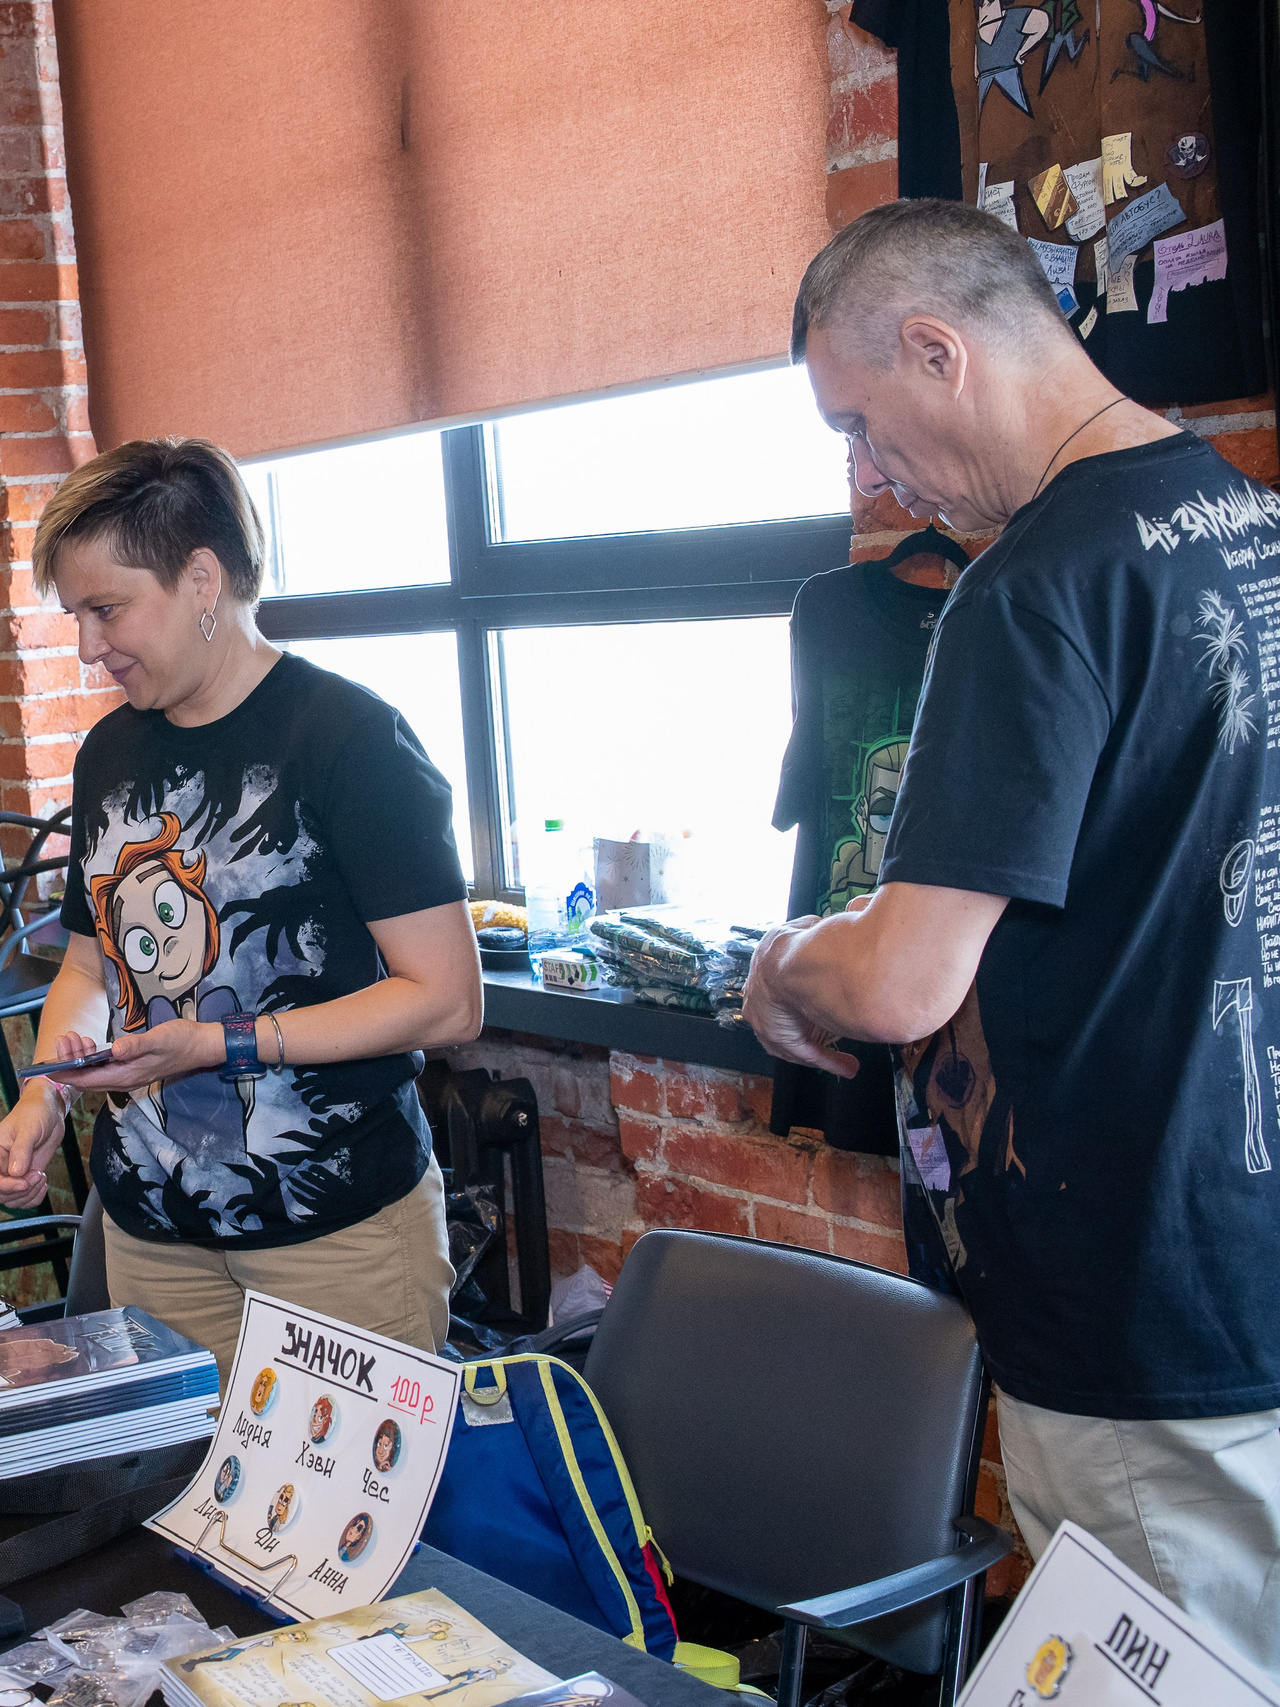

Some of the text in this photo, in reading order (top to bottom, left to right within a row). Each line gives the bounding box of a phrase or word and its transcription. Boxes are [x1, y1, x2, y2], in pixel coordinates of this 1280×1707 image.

[281, 1321, 377, 1392] ЗНАЧОК
[392, 1642, 433, 1678] ТЕТРАДЬ
[1104, 1612, 1170, 1688] ПИН
